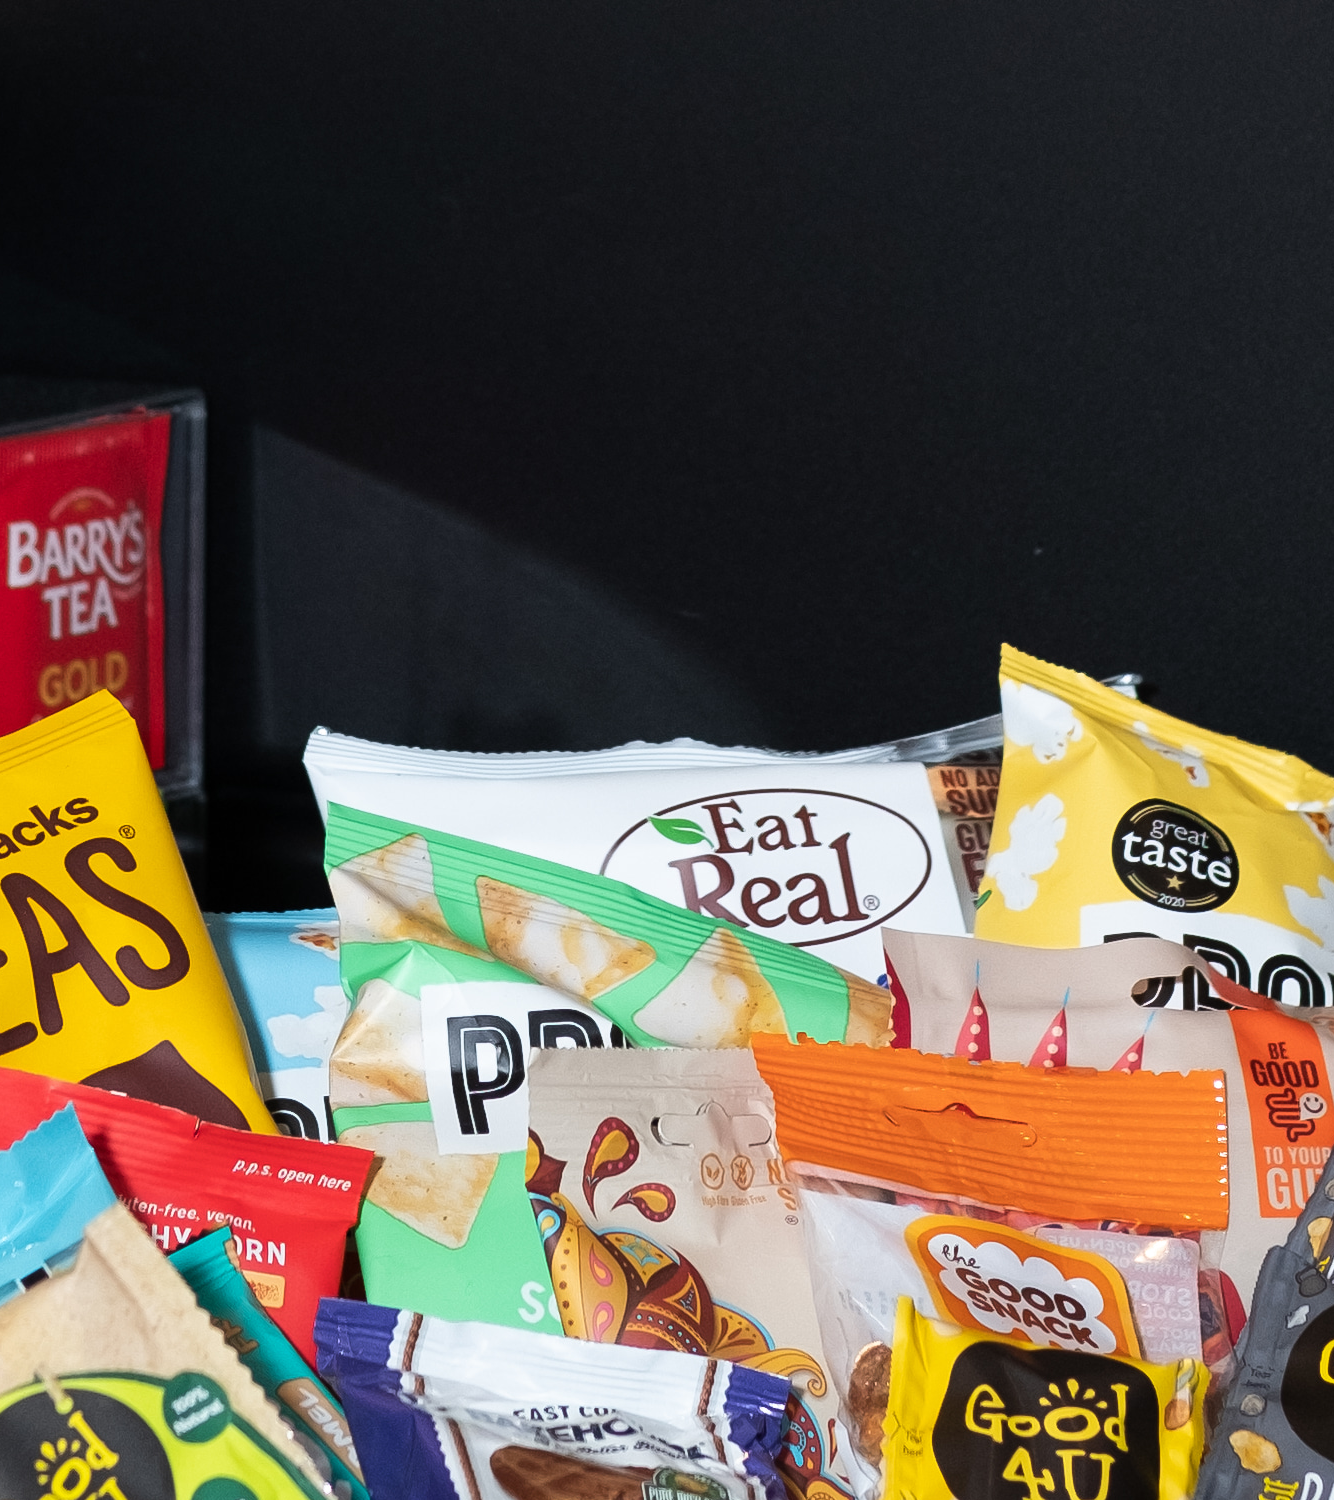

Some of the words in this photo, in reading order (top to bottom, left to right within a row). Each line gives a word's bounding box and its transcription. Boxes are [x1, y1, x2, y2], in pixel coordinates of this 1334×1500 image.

[7, 499, 144, 588] BARRY'S
[41, 576, 119, 641] TEA
[38, 652, 129, 708] GOLD
[940, 768, 968, 788] NO
[700, 799, 823, 854] Eat
[1149, 819, 1210, 850] great
[668, 832, 869, 929] Real
[1121, 831, 1233, 889] taste
[1156, 892, 1186, 908] 2020
[1250, 1059, 1320, 1089] GOOD
[1267, 1041, 1287, 1061] BE
[232, 1157, 273, 1177] p.p.s.
[277, 1166, 315, 1186] open
[316, 1171, 352, 1192] here
[1263, 1146, 1286, 1166] TO
[1287, 1146, 1331, 1165] YOUR
[941, 1242, 980, 1272] the
[955, 1266, 1088, 1323] GOOD
[966, 1289, 1101, 1350] SNACK
[965, 1383, 1130, 1452] Good
